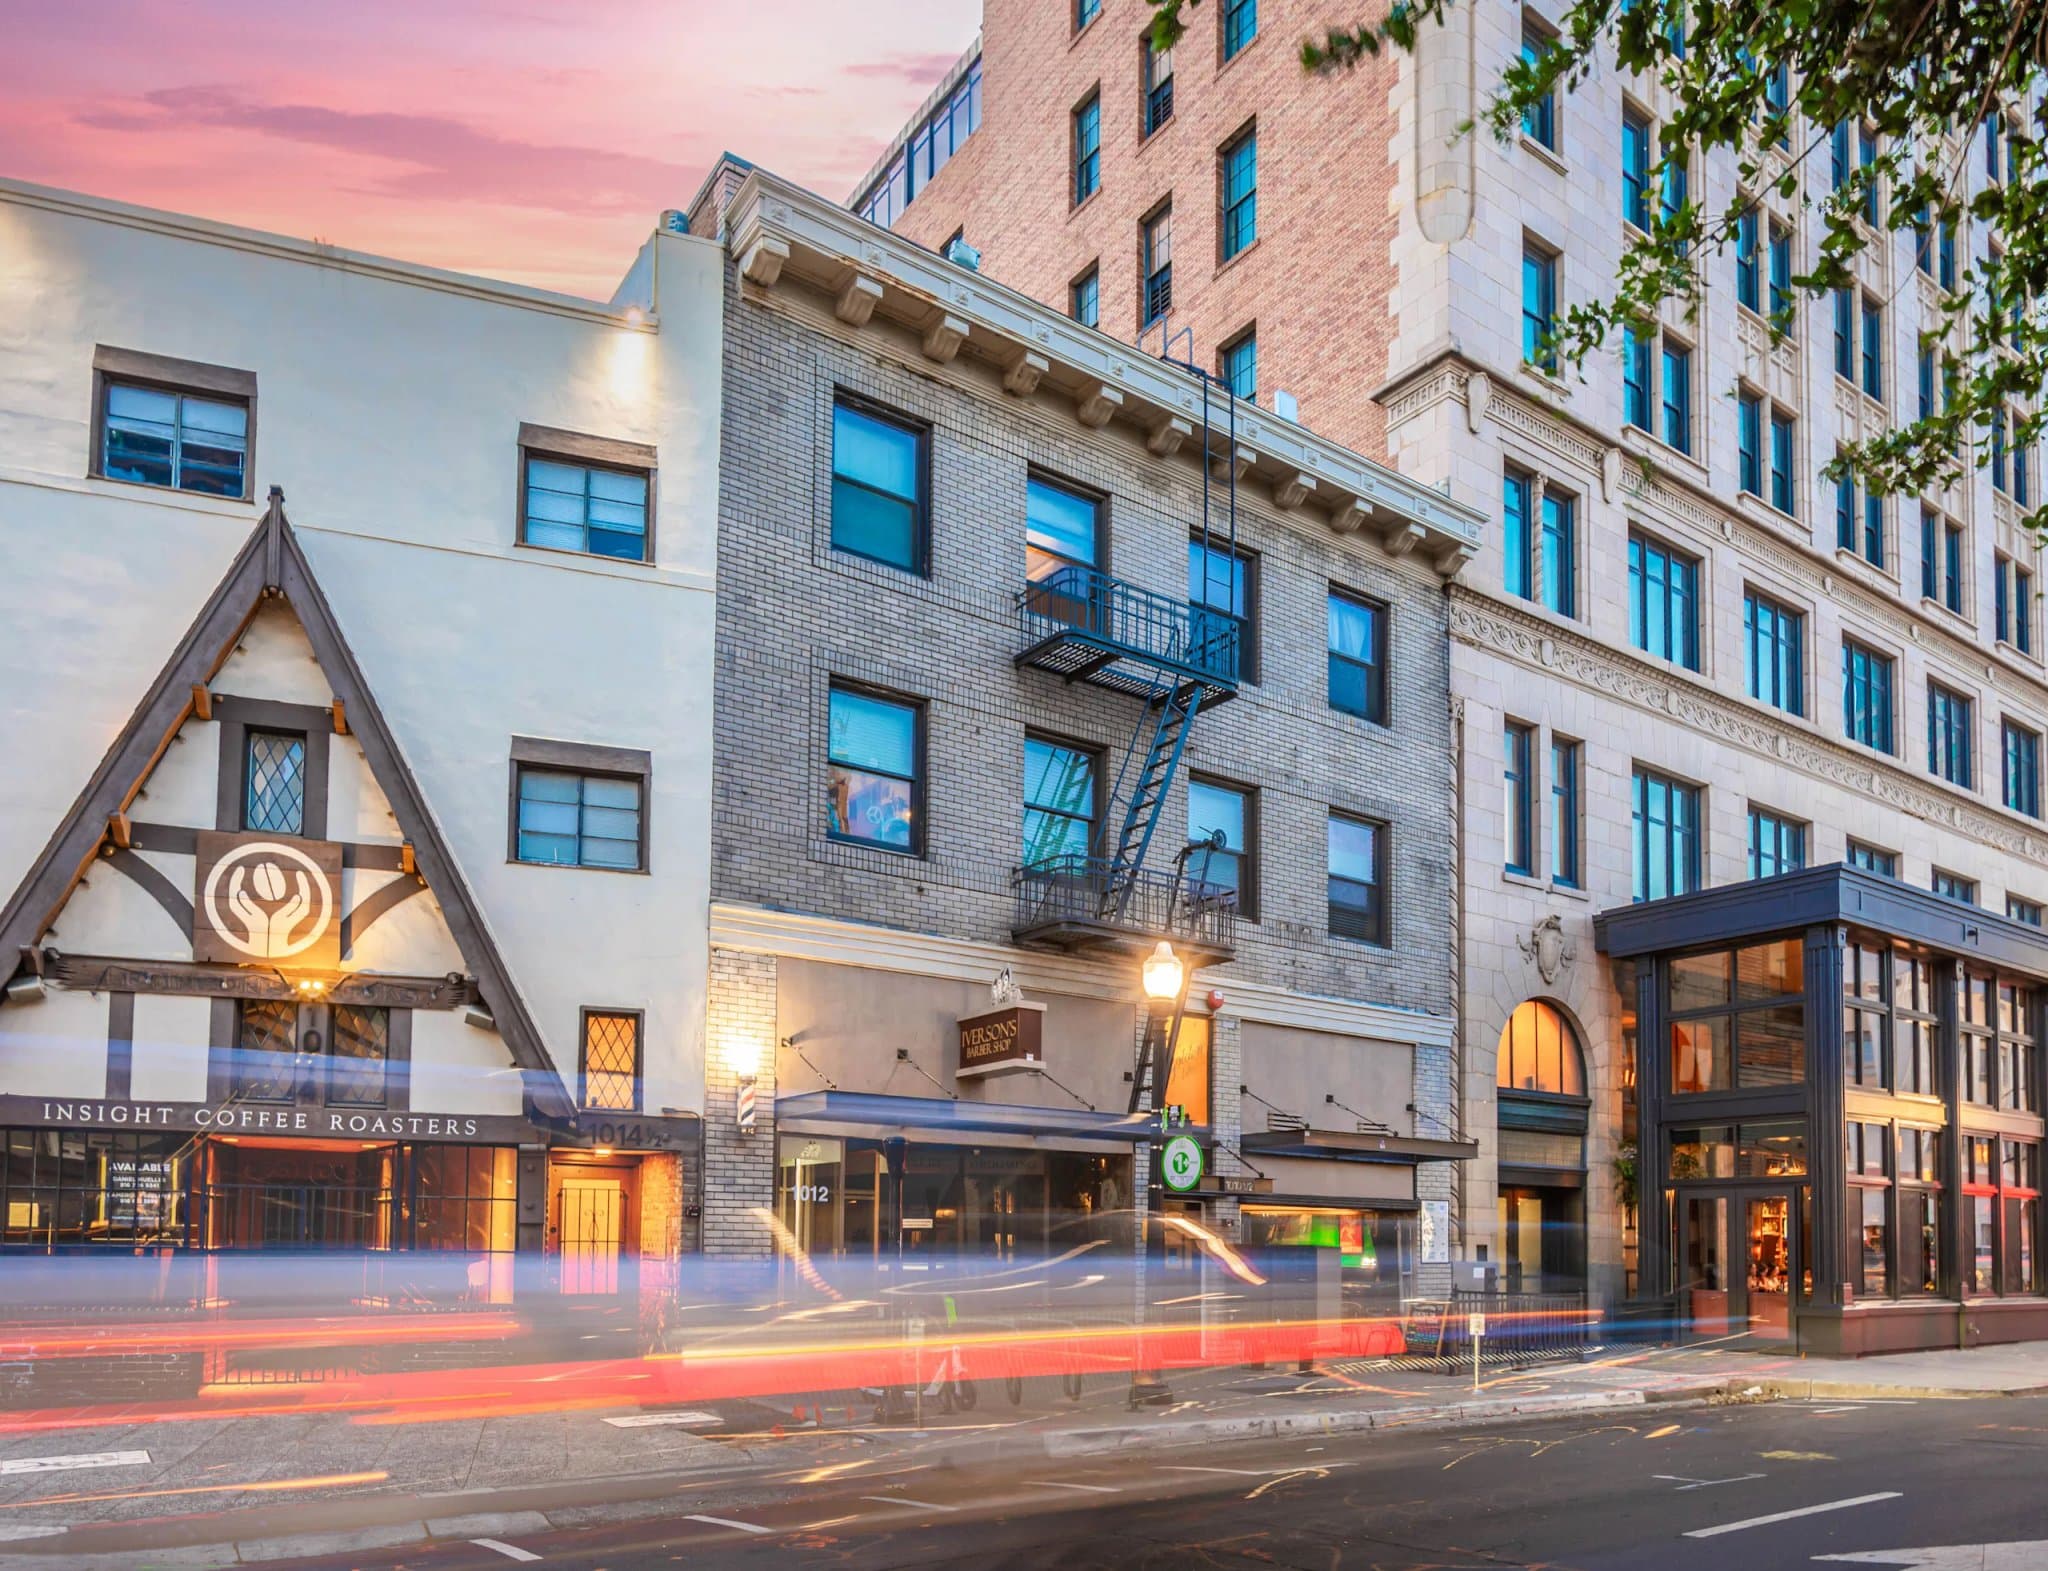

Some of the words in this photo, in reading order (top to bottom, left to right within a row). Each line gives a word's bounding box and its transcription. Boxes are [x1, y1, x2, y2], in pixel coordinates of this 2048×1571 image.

[962, 1019, 1017, 1048] IVERSON'S
[966, 1043, 992, 1058] BARBER
[992, 1039, 1012, 1054] SHOP
[43, 1103, 174, 1123] INSIGHT
[194, 1109, 308, 1129] COFFEE
[329, 1114, 478, 1136] ROASTERS
[588, 1122, 643, 1147] 1014
[791, 1184, 829, 1203] 1012
